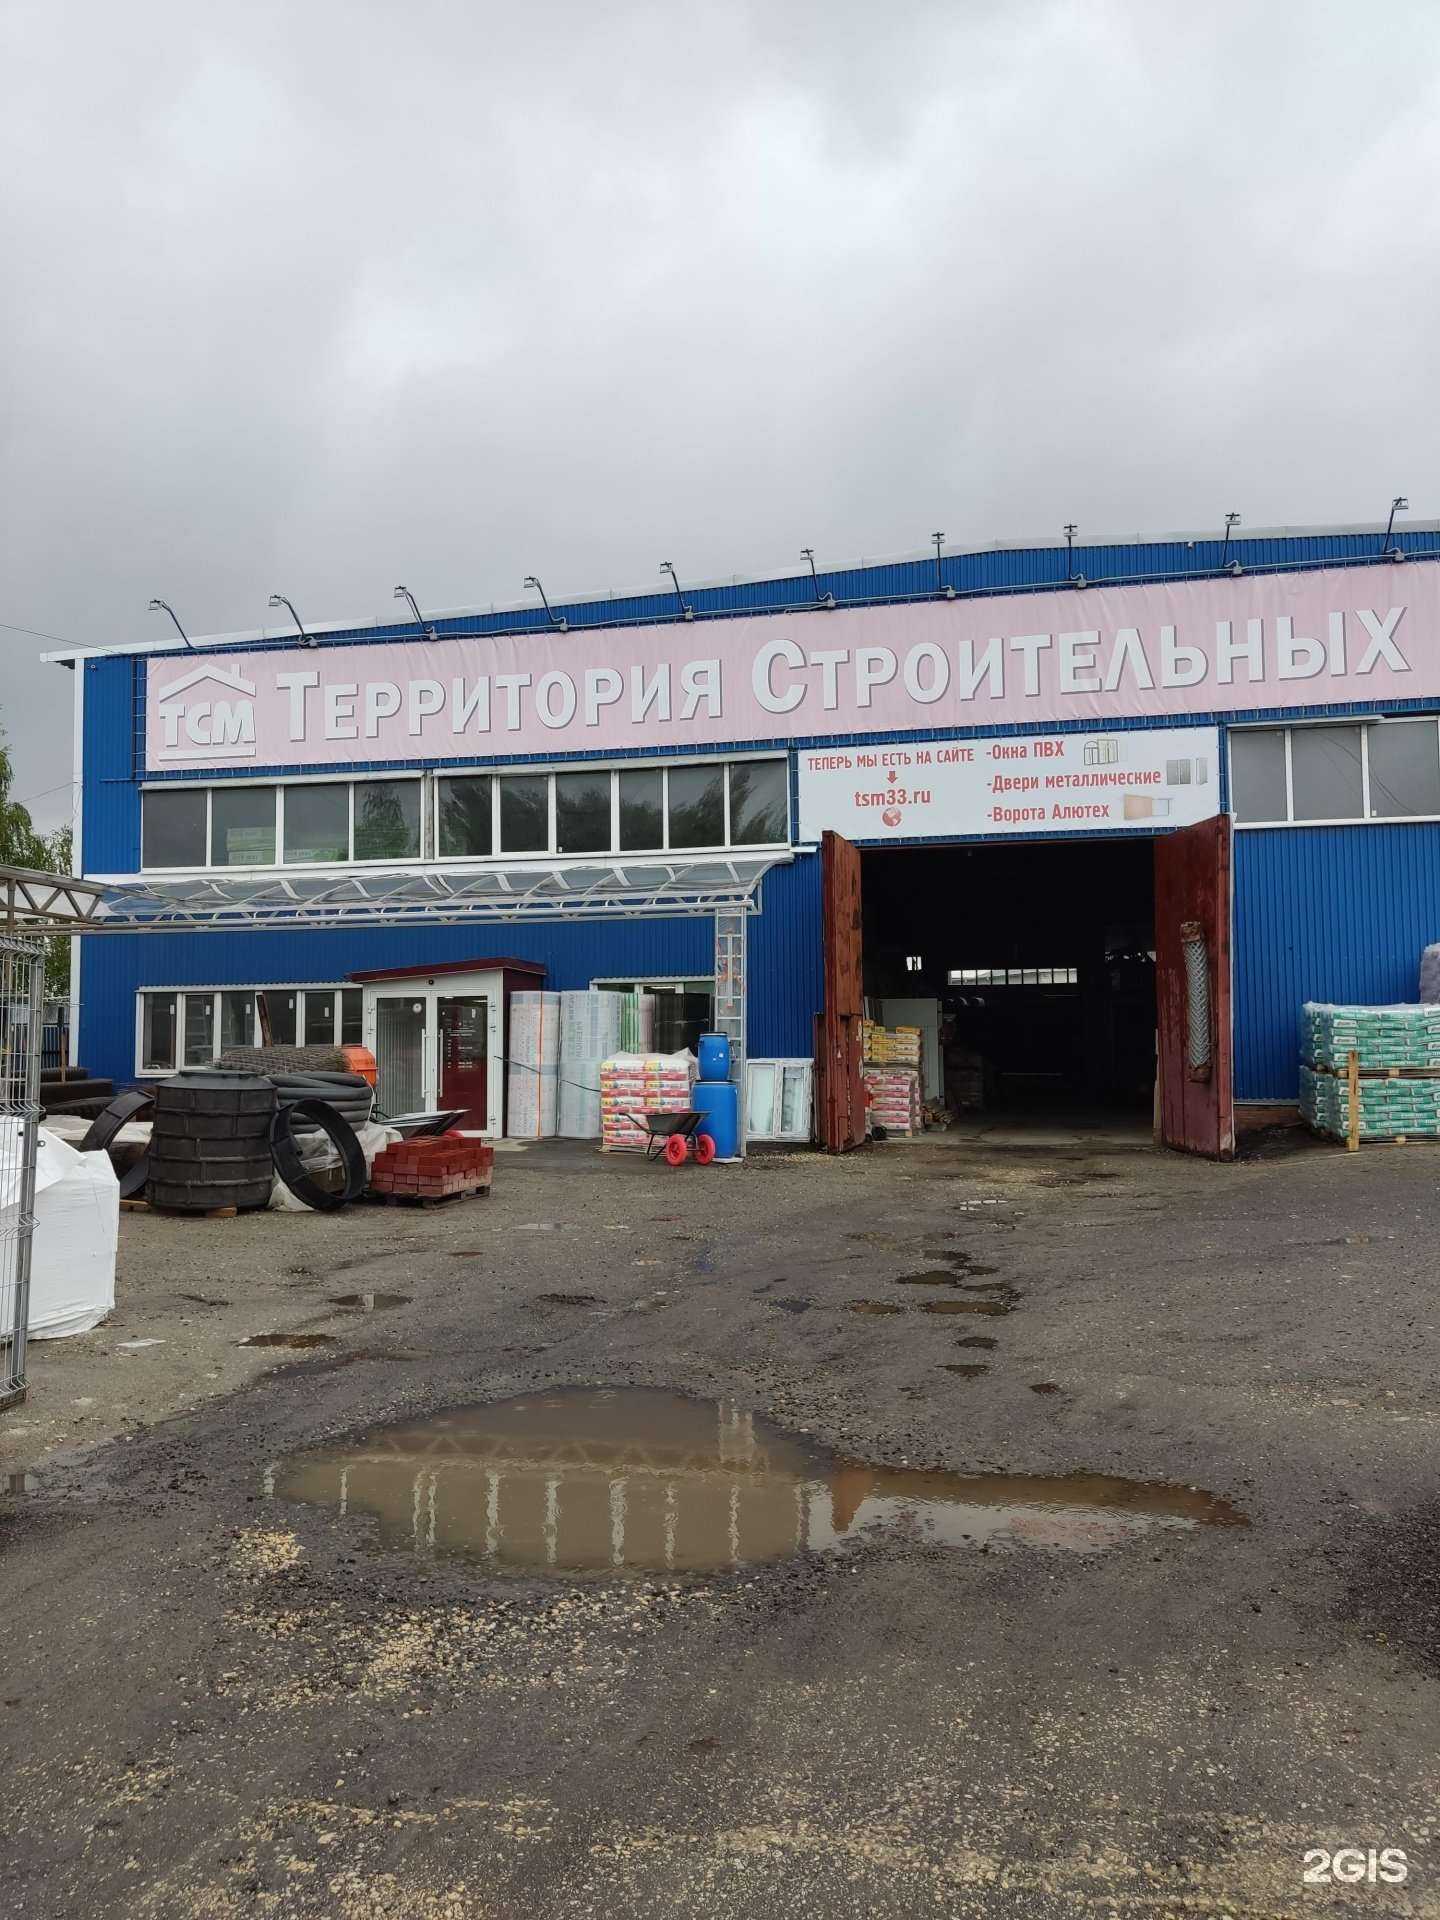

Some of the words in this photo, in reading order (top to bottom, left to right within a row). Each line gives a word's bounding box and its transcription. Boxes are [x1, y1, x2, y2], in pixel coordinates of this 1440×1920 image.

[275, 657, 723, 743] ТЕРРИТОРИЯ
[751, 605, 1411, 713] СТРОИТЕЛЬНЫХ
[159, 700, 257, 747] ТСМ
[808, 755, 852, 771] ТЕПЕРЬ
[857, 754, 878, 769] МЫ
[882, 752, 911, 767] ЕСТЬ
[916, 751, 932, 765] НА
[936, 747, 974, 763] САЙТЕ
[986, 744, 1028, 760] -Окна
[1034, 741, 1065, 758] ПВХ
[986, 775, 1039, 793] -Двери
[1045, 770, 1161, 788] металлические
[854, 789, 931, 807] tsm33.ru
[986, 807, 1046, 825] -Ворота
[1051, 803, 1110, 821] Алютех
